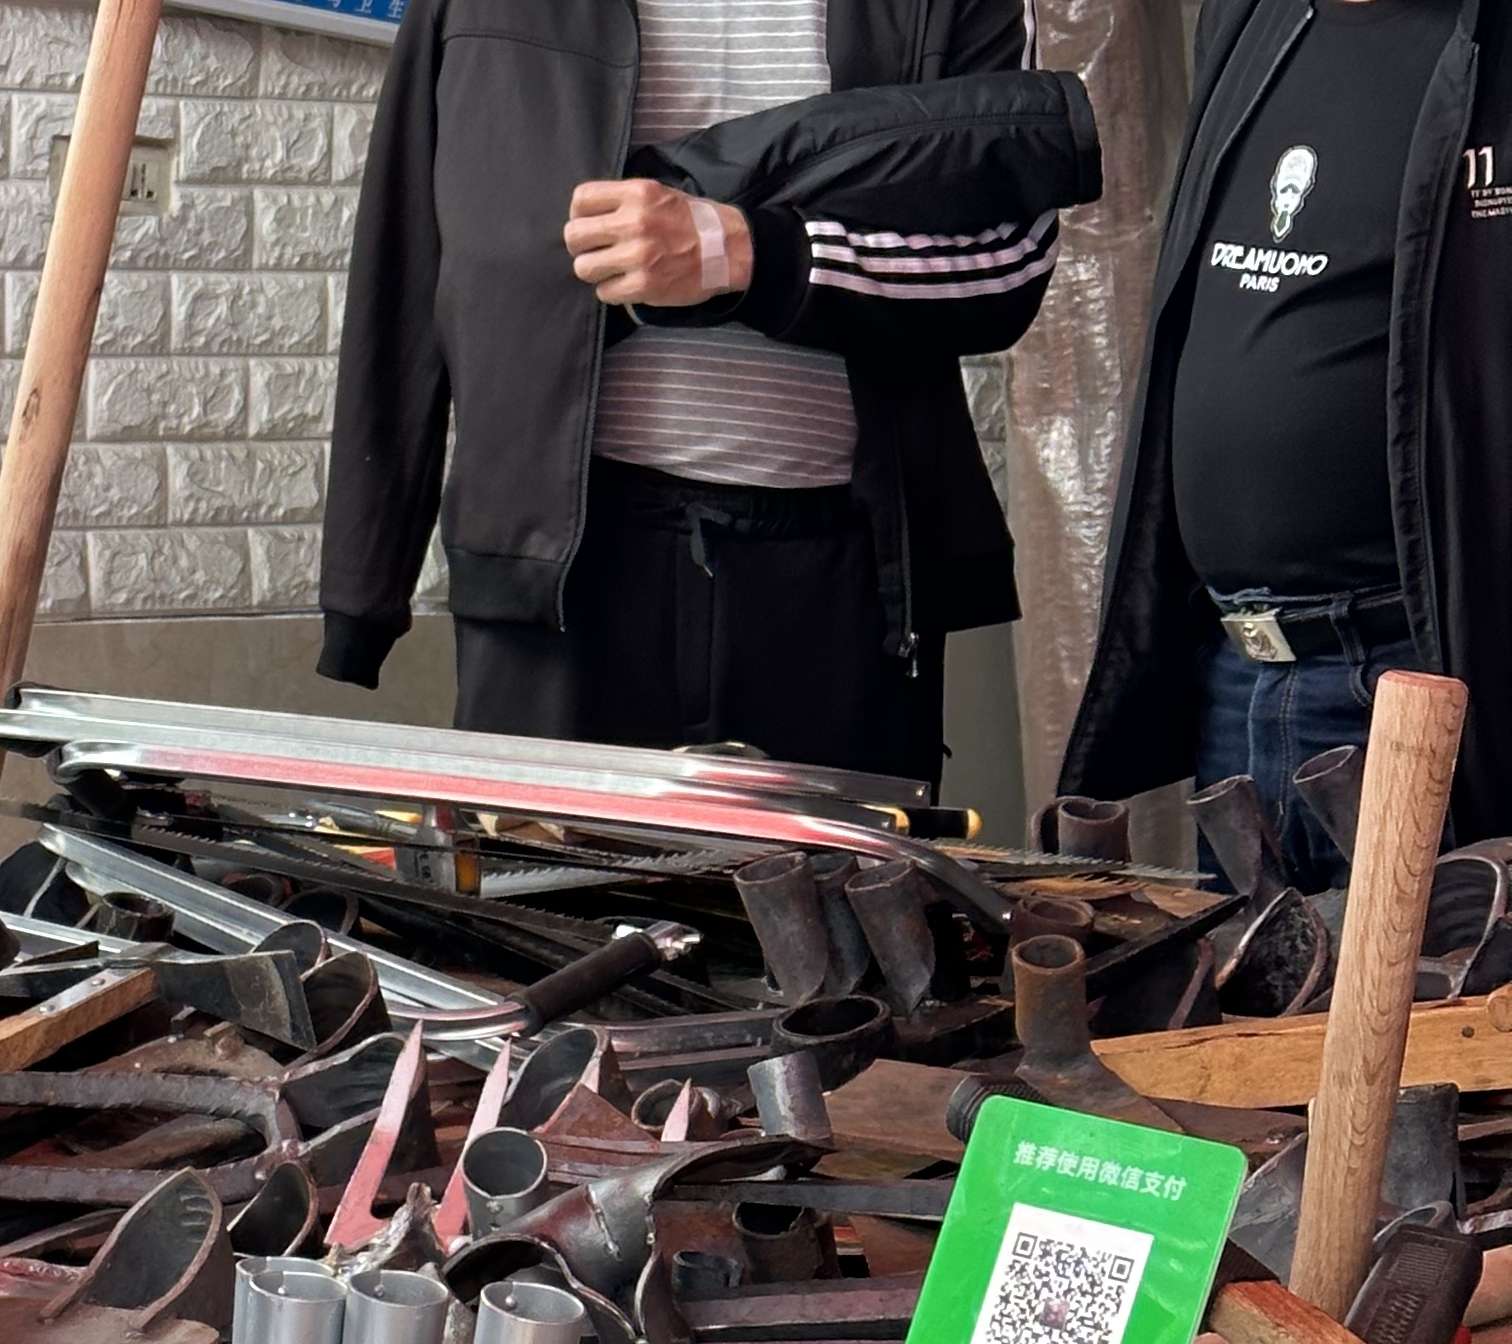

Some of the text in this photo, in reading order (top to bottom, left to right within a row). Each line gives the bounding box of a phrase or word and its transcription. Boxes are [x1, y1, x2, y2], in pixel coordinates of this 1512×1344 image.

[1239, 274, 1280, 292] PARIS
[1012, 1139, 1187, 1201] 推荐使用微信支付
